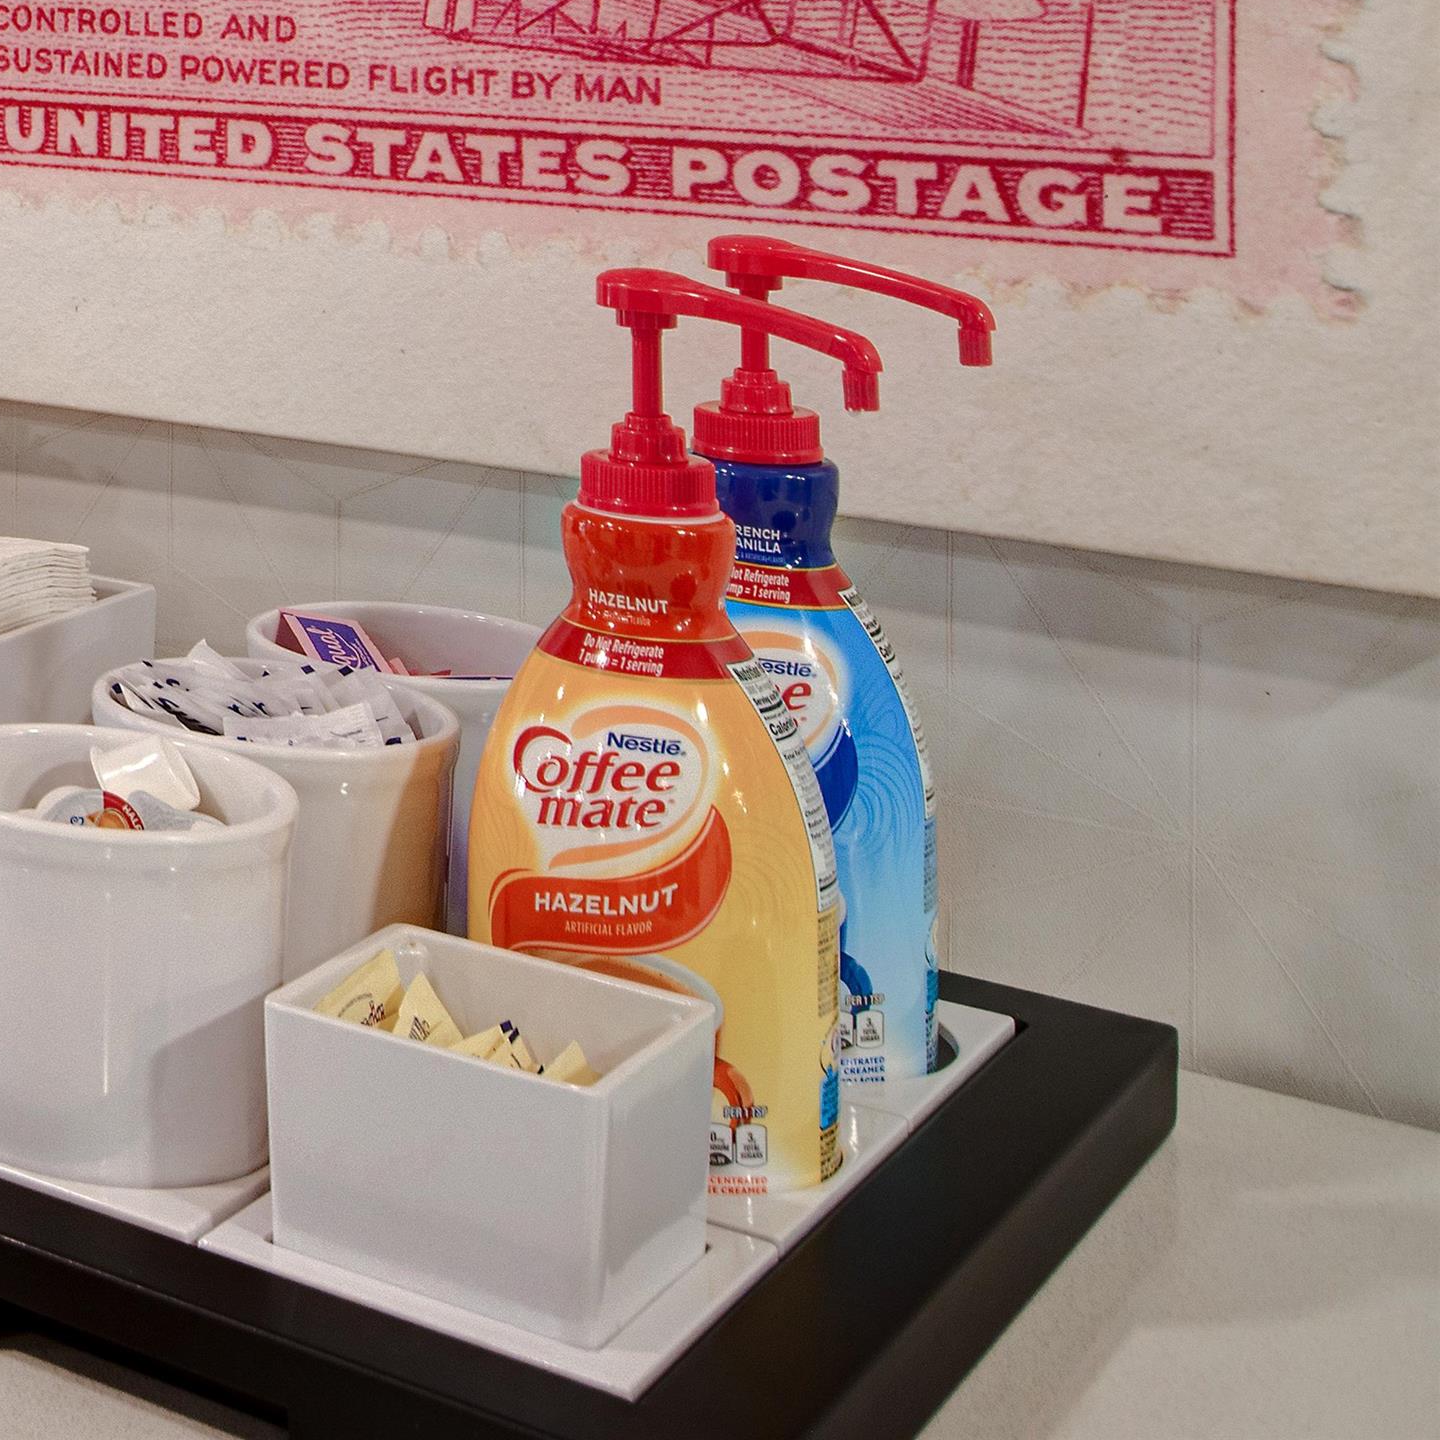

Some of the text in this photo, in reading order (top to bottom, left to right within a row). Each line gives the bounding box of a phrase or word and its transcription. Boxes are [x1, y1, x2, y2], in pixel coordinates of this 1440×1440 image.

[222, 14, 297, 44] AND
[181, 57, 350, 91] POWERED
[367, 65, 499, 99] FLIGHT
[510, 71, 562, 101] BY
[574, 73, 663, 107] MAN
[3, 105, 1163, 233] UNITED STATES POSTAGE
[735, 524, 780, 541] RENCH
[736, 538, 781, 554] ANILLA
[744, 568, 790, 587] Refrigerate
[588, 588, 668, 614] HAZELNUT
[727, 583, 744, 597] mp
[758, 587, 791, 604] serving
[304, 624, 356, 668] qual
[583, 633, 664, 659] Do Not Refrigerate
[583, 651, 610, 669] pup
[626, 660, 664, 677] serving
[513, 726, 681, 794] Coffee
[537, 796, 666, 829] mate
[534, 882, 680, 916] HAZELNUT
[564, 919, 653, 936] ARTIFICIAL FLAVOR
[840, 1056, 885, 1066] ENTRATED
[708, 1175, 768, 1185] CENTRATED
